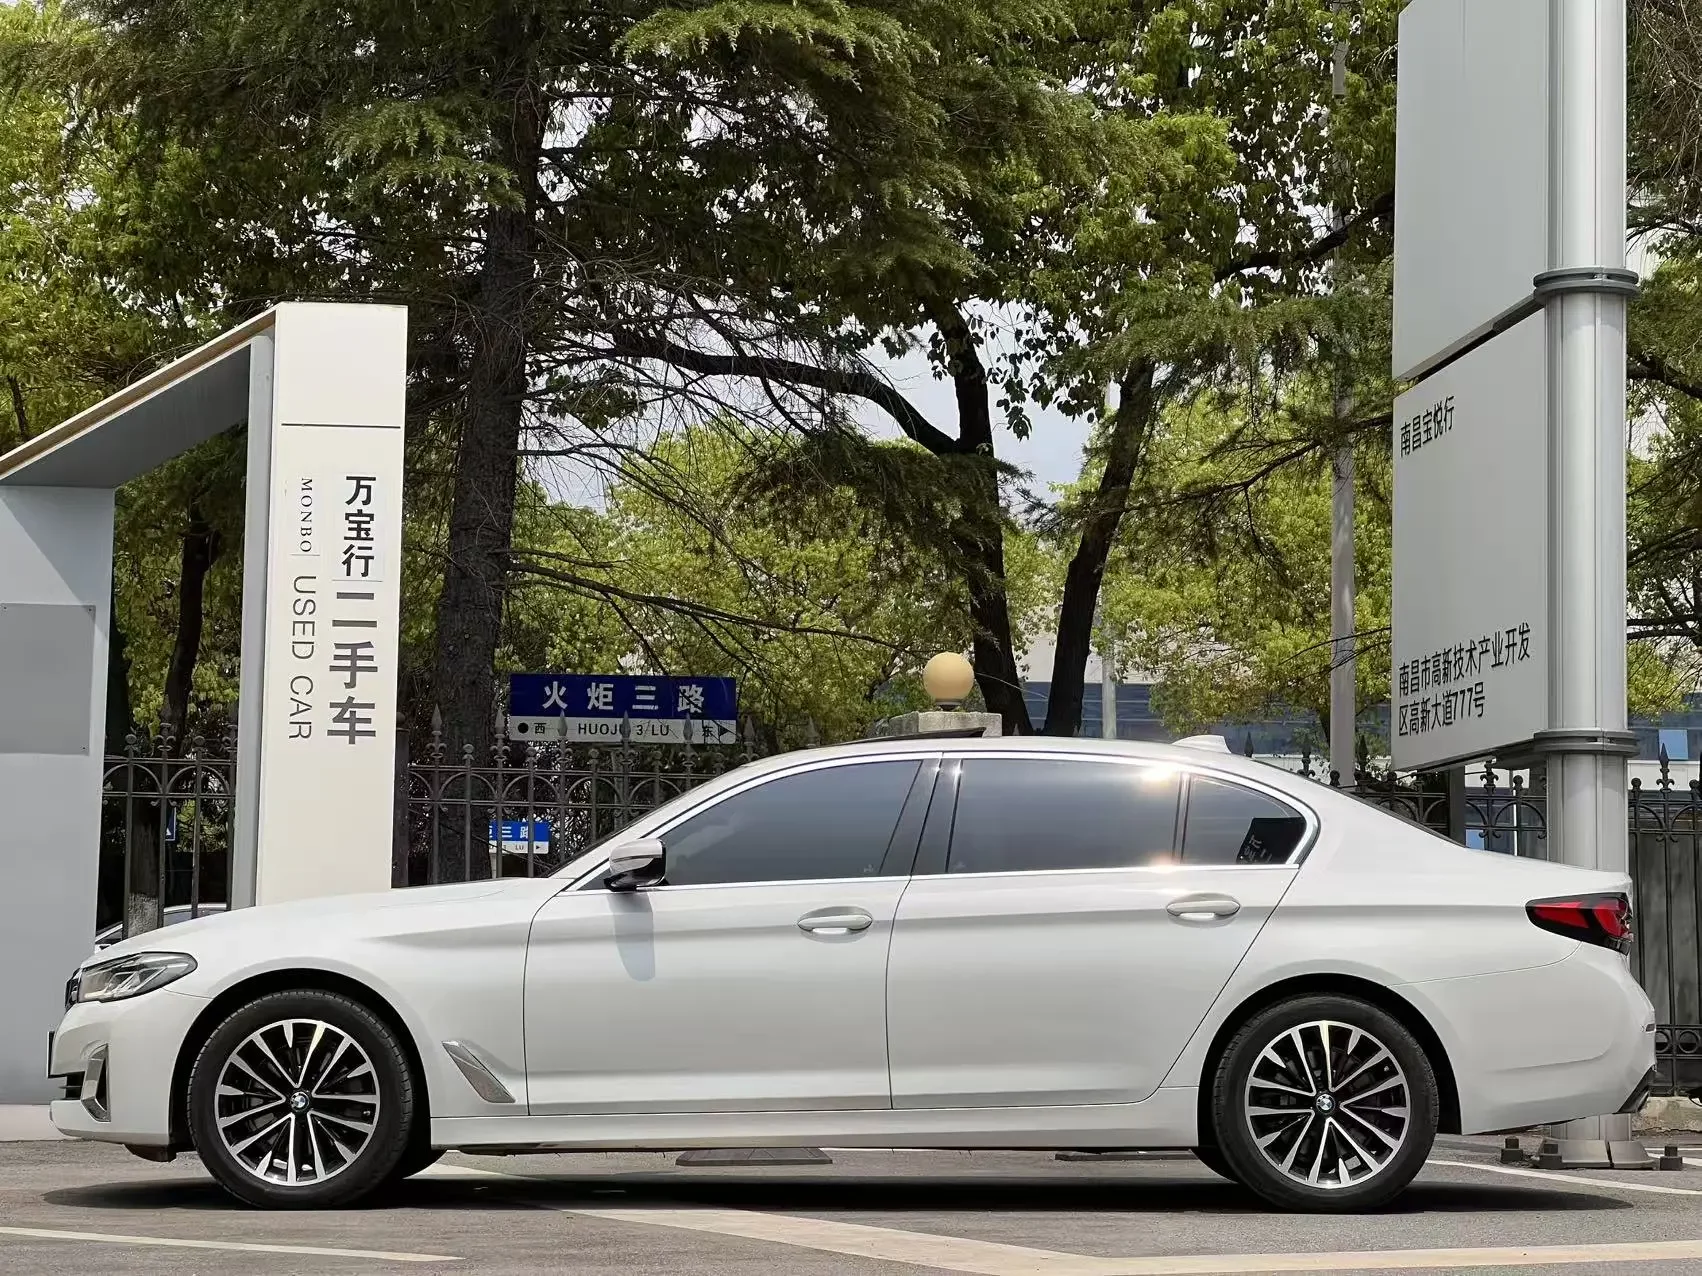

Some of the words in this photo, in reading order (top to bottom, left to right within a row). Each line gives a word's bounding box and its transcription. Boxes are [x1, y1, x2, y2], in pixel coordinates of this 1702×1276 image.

[1400, 395, 1455, 458] 南昌宝悦行
[300, 477, 313, 553] MONBO
[341, 475, 377, 578] 万宝行
[292, 575, 317, 660] USED
[326, 591, 378, 745] 二手车
[1399, 622, 1531, 698] 南昌市高新技术产业开发
[288, 675, 314, 739] CAR
[533, 722, 547, 734] 西
[542, 681, 704, 713] 火炬三路
[1399, 681, 1486, 737] 区高新大道777号
[577, 723, 629, 735] HUOJ
[636, 724, 644, 736] 3
[651, 724, 670, 736] LU
